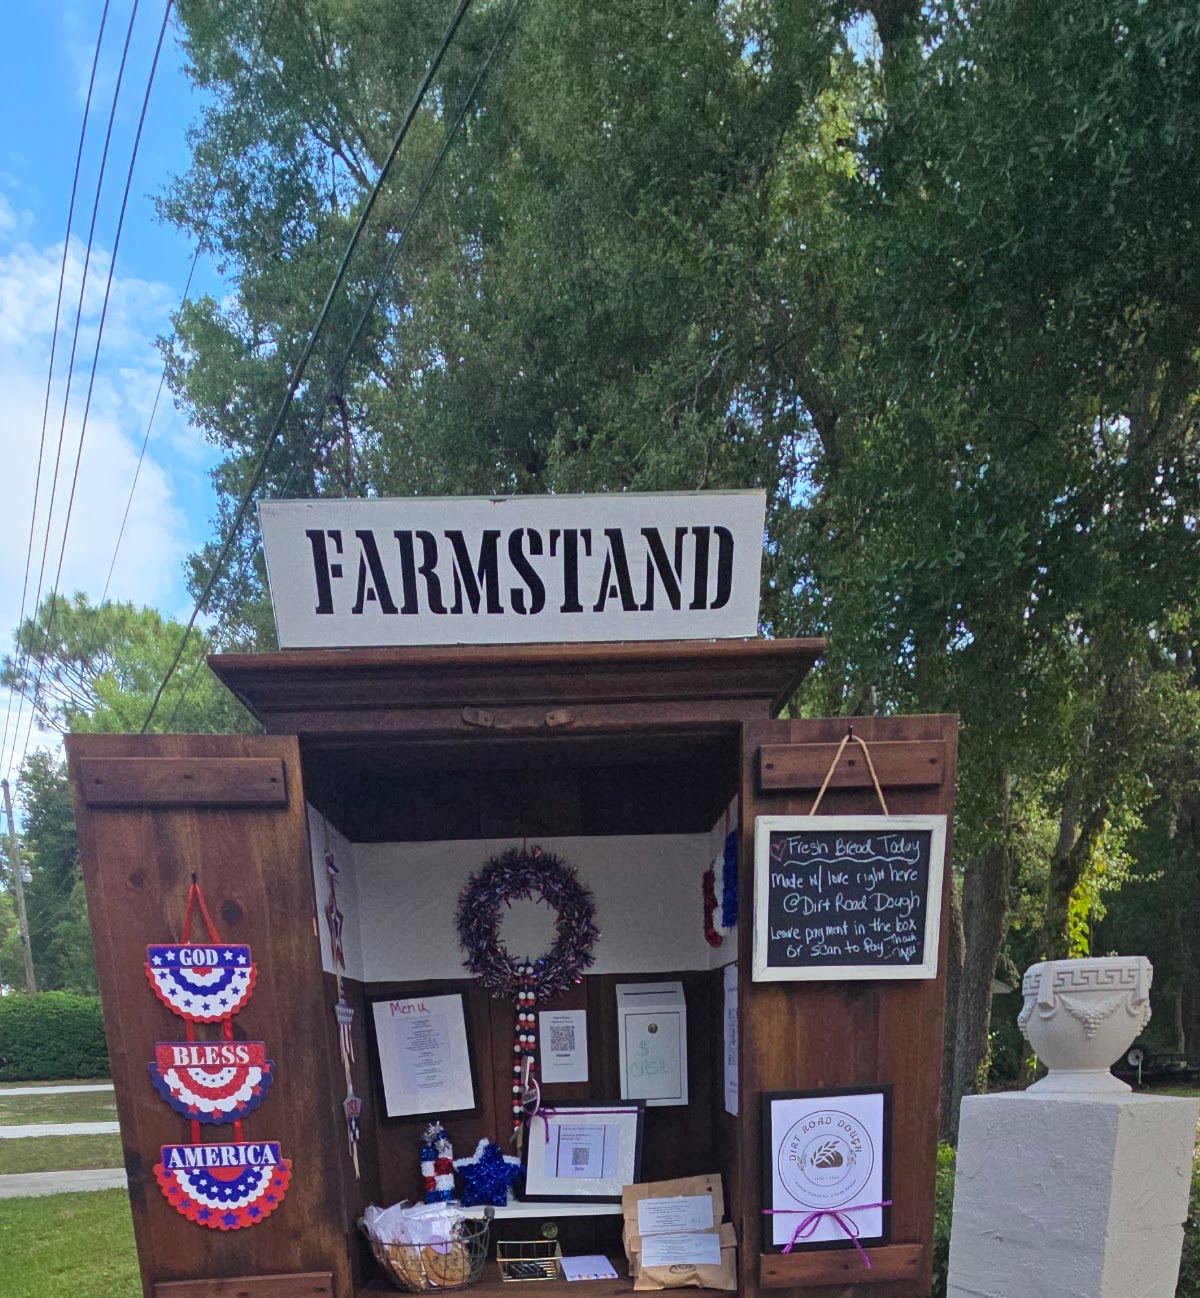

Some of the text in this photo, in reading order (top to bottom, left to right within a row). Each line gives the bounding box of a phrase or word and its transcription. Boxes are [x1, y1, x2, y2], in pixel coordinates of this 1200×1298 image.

[305, 525, 735, 615] FARMSTAND
[787, 834, 920, 860] Fresh Bread Today
[772, 873, 803, 889] Made
[828, 871, 848, 885] love
[857, 868, 885, 890] right
[889, 863, 918, 881] here
[835, 893, 868, 911] Road
[869, 891, 920, 917] Dough
[771, 917, 917, 944] Leave payment in the box
[179, 949, 219, 966] GOD
[810, 944, 841, 957] scan
[845, 941, 859, 954] to
[389, 1001, 431, 1017] Menu
[172, 1045, 250, 1066] BLESS
[789, 1116, 862, 1161] DIRT ROAD DOUGH
[167, 1144, 277, 1168] AMERICA
